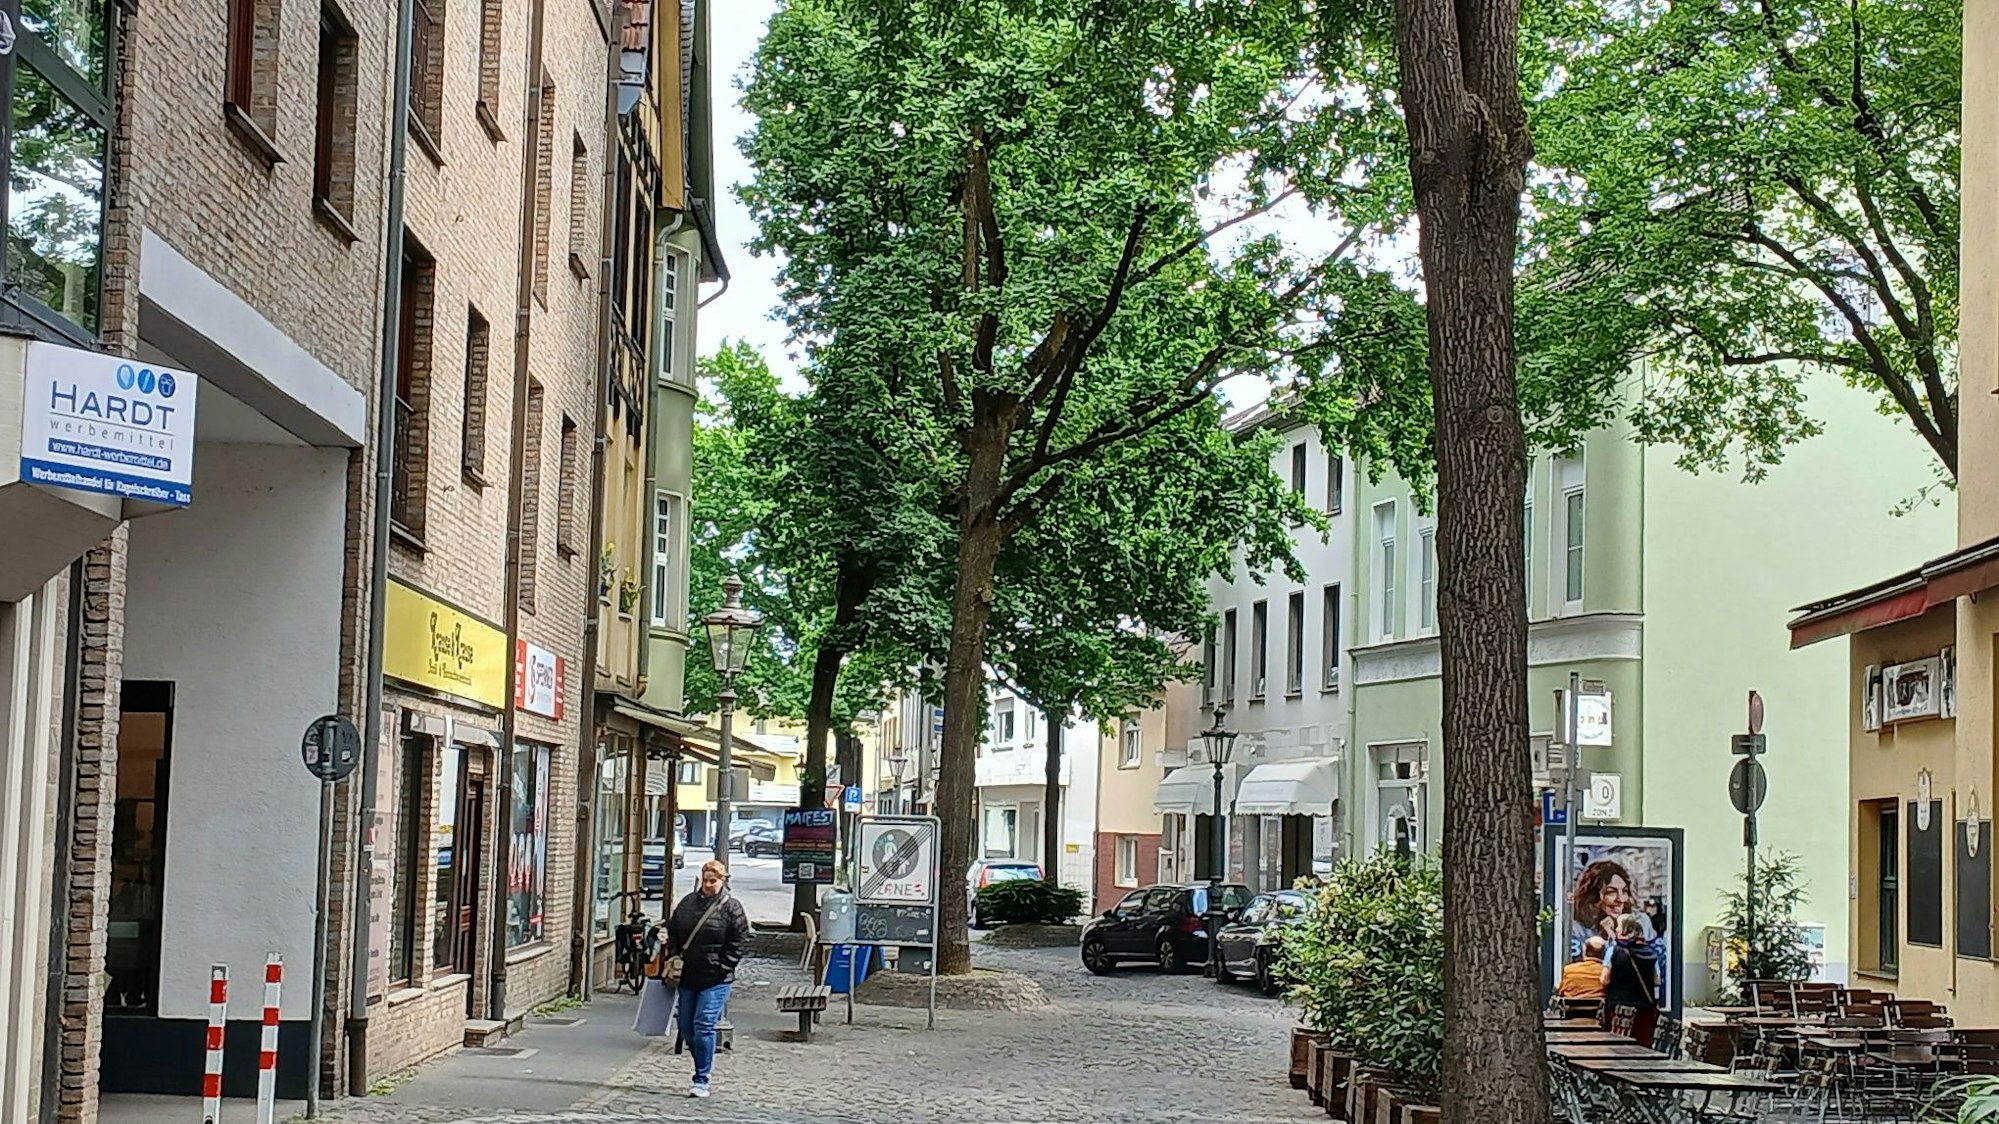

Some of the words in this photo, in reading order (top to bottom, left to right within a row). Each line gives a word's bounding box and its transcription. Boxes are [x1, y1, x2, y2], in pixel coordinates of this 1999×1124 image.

[51, 380, 175, 430] HARDT
[50, 420, 174, 451] werbemittel
[52, 441, 169, 471] www.hardt-werbemittel.de
[785, 810, 835, 827] MAIFEST
